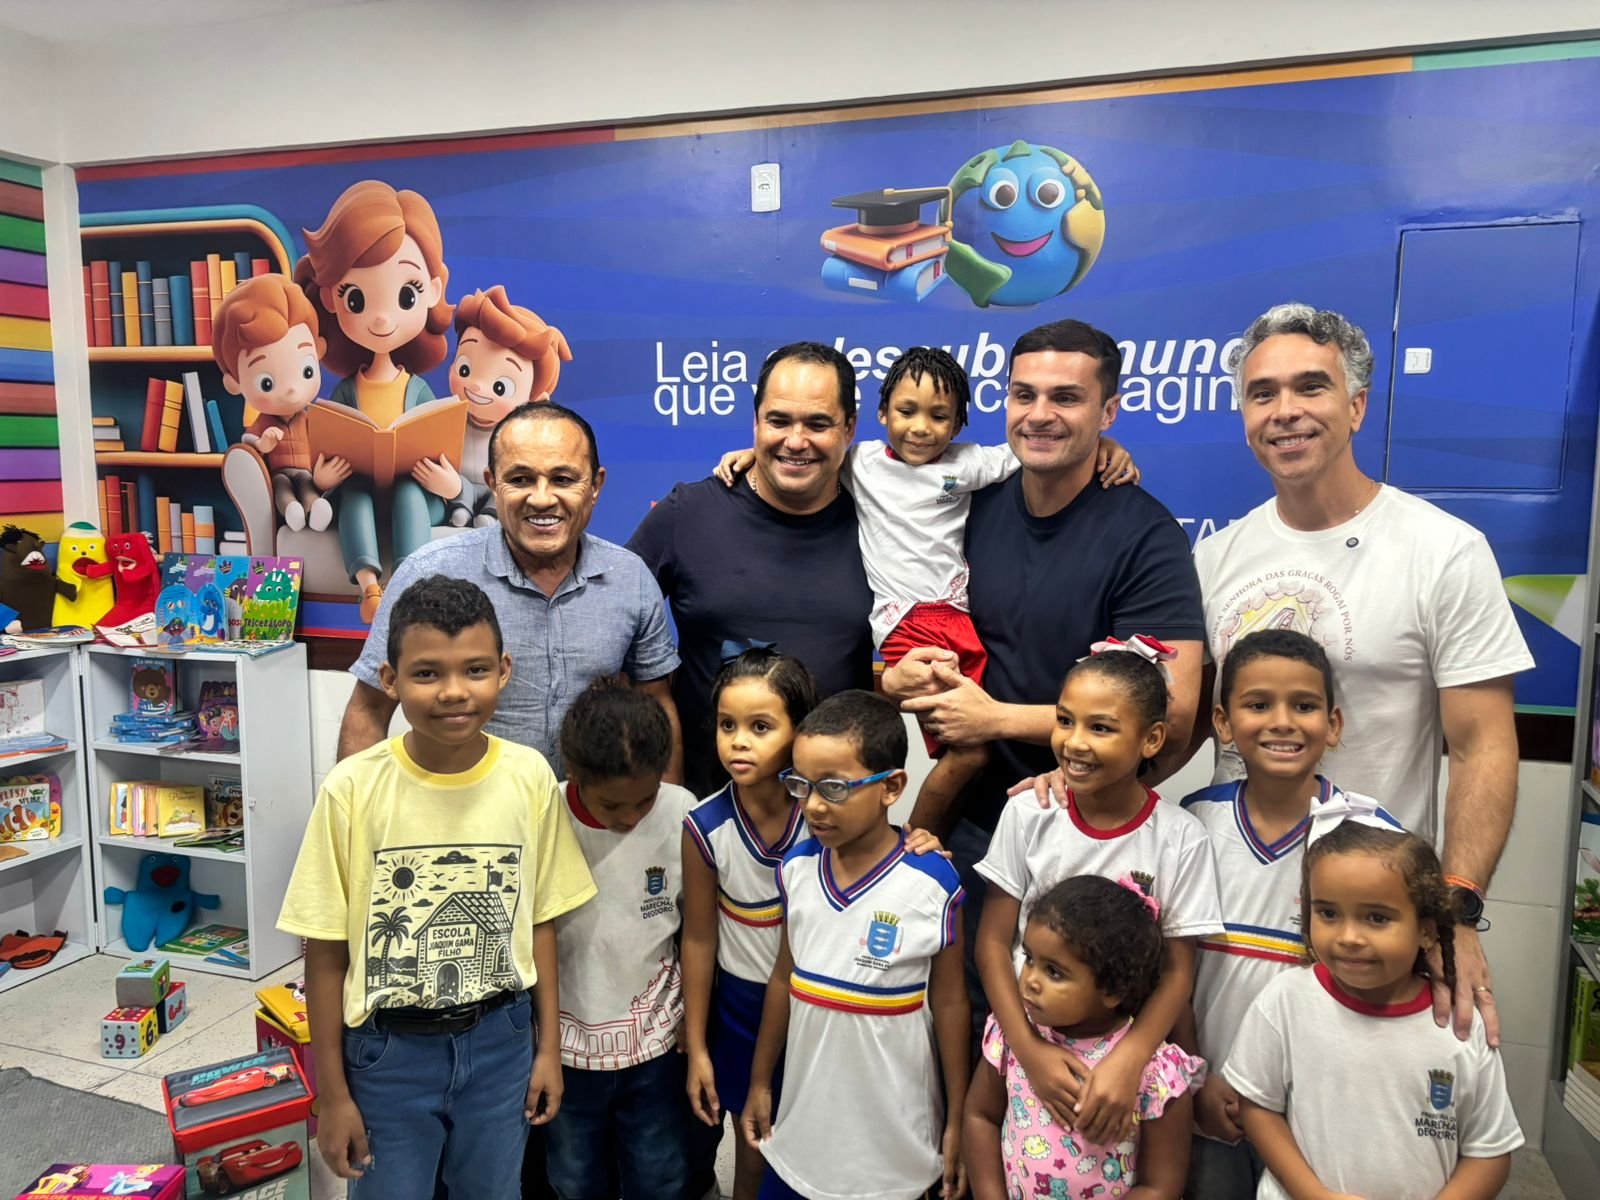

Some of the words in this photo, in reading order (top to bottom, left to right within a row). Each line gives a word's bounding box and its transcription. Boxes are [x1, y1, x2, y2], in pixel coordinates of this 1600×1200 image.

[656, 341, 747, 383] Leia
[653, 383, 736, 426] que
[1265, 570, 1286, 580] DAS
[1287, 569, 1325, 584] GRAÇAS
[1222, 577, 1263, 613] SENHORA
[1324, 580, 1346, 610] ROGAI
[1341, 610, 1352, 635] POR
[1344, 638, 1356, 662] NÓS
[432, 927, 471, 939] ESCOLA
[455, 938, 474, 947] GAMA
[438, 948, 462, 957] FILHO
[114, 1034, 126, 1050] 9
[145, 1020, 154, 1047] 6
